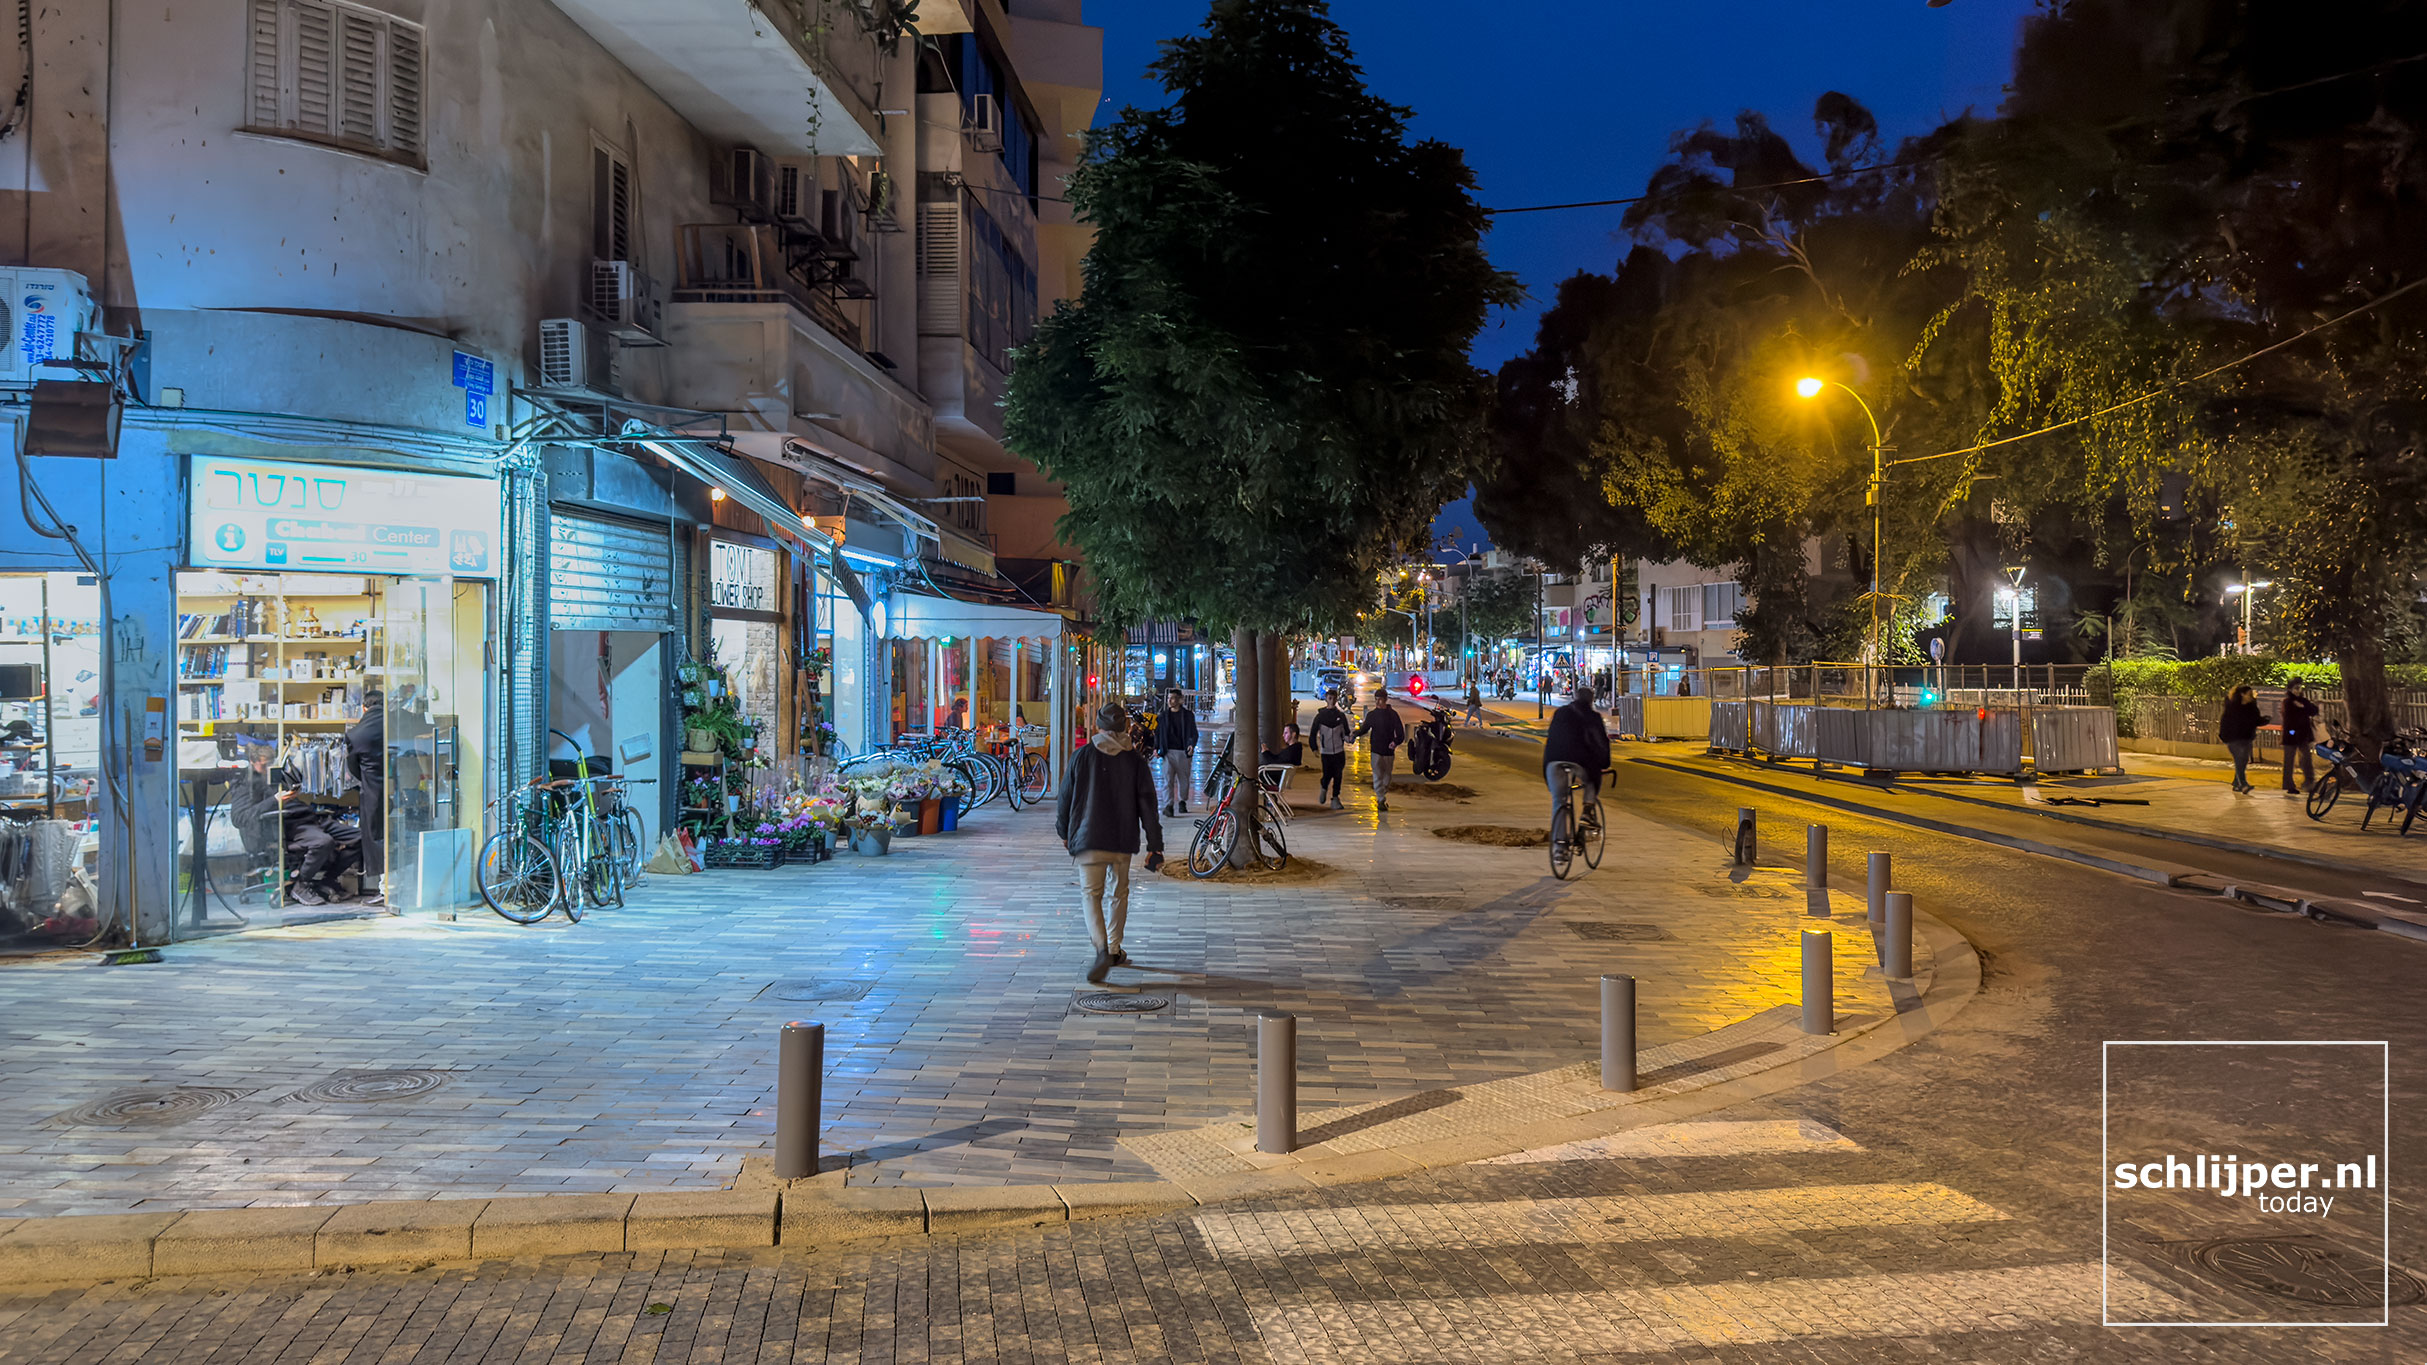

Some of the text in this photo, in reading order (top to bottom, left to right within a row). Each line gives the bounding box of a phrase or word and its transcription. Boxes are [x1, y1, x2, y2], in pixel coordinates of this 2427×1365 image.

[470, 399, 484, 419] 30
[214, 469, 346, 511] סנטר
[373, 526, 431, 544] Center
[269, 547, 284, 557] TLV
[351, 552, 367, 563] 30
[711, 582, 763, 609] LOWER SHOP
